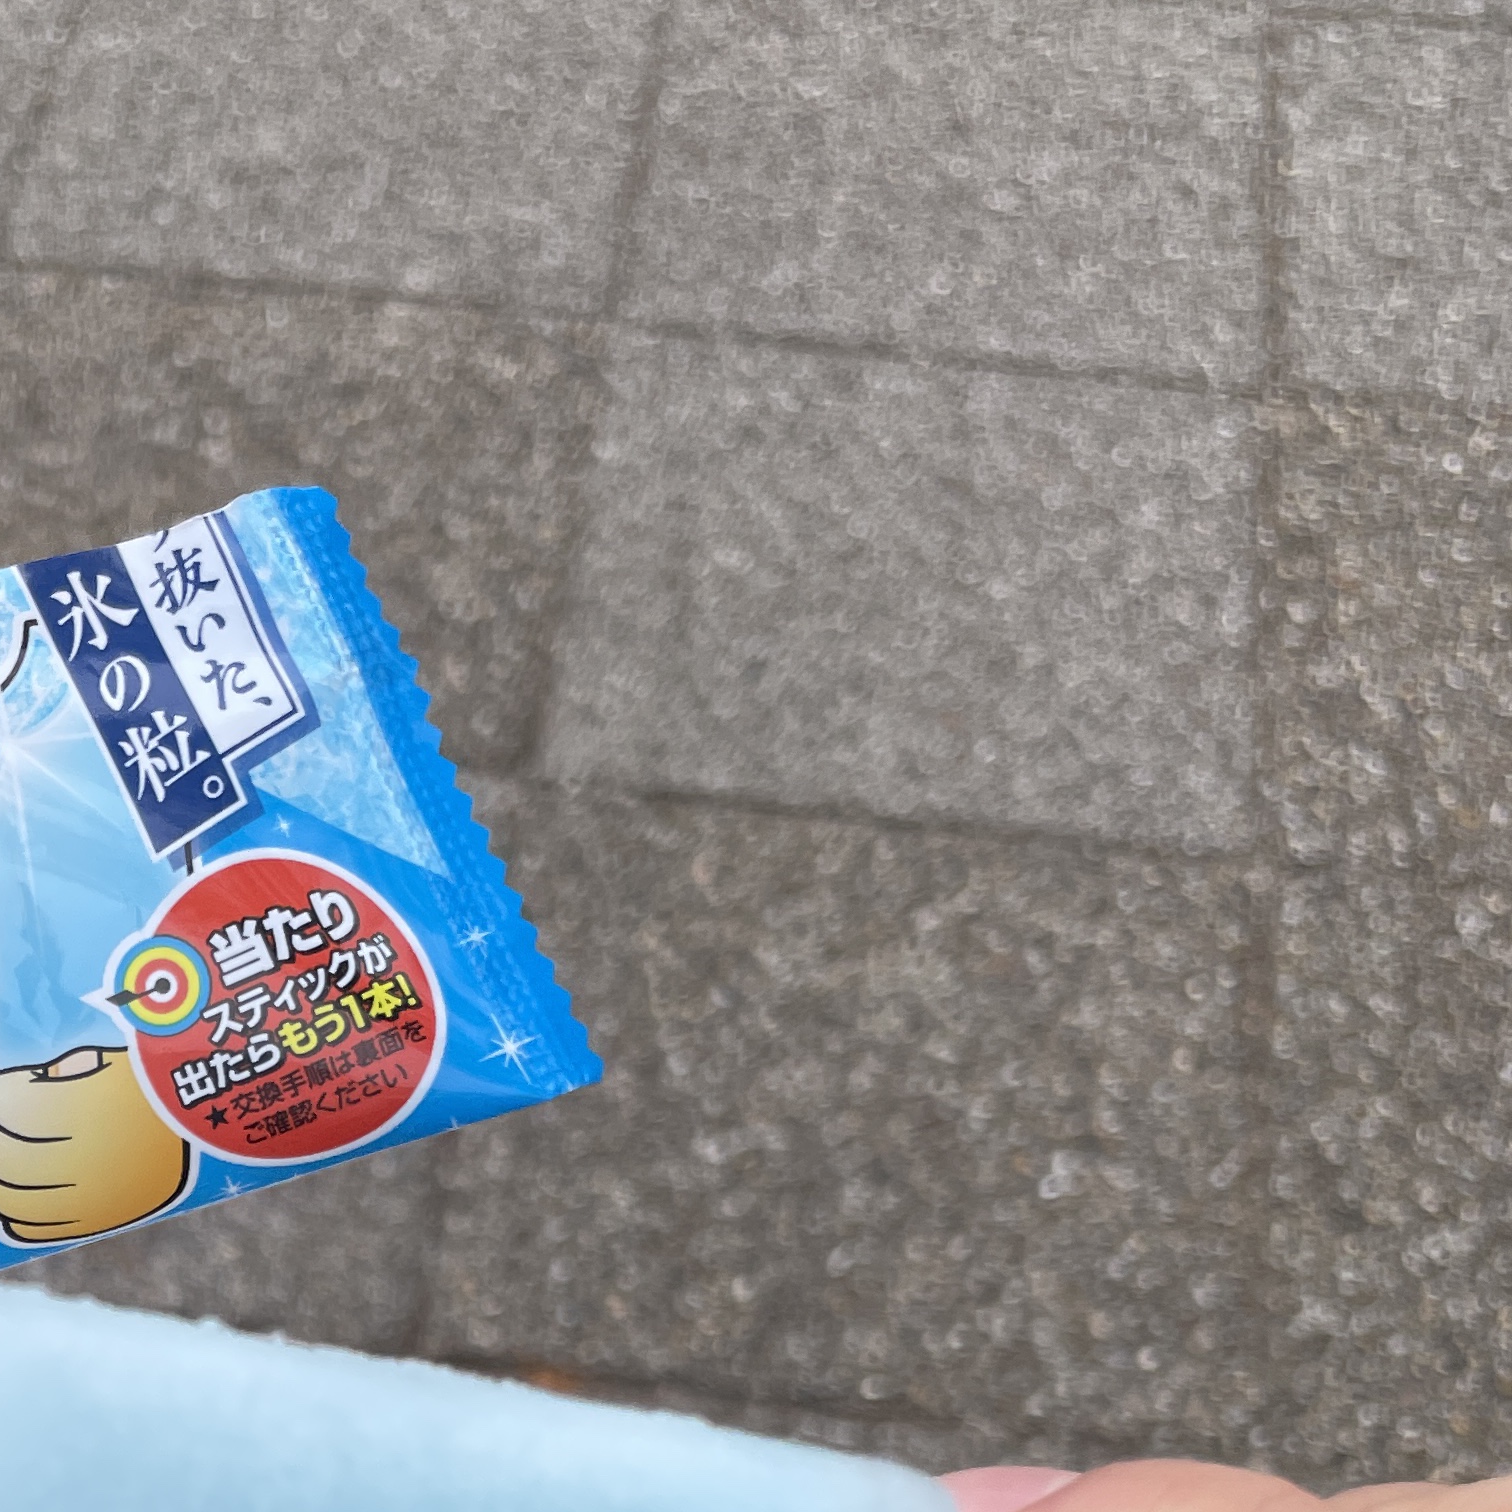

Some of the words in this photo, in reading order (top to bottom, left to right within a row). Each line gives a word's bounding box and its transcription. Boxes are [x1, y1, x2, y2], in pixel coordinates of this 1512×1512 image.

[150, 530, 273, 711] 抜いた、
[49, 570, 226, 803] 氷の粒。
[202, 934, 395, 1045] スティックが
[207, 889, 358, 988] 当たり
[242, 1062, 410, 1145] ご確認ください
